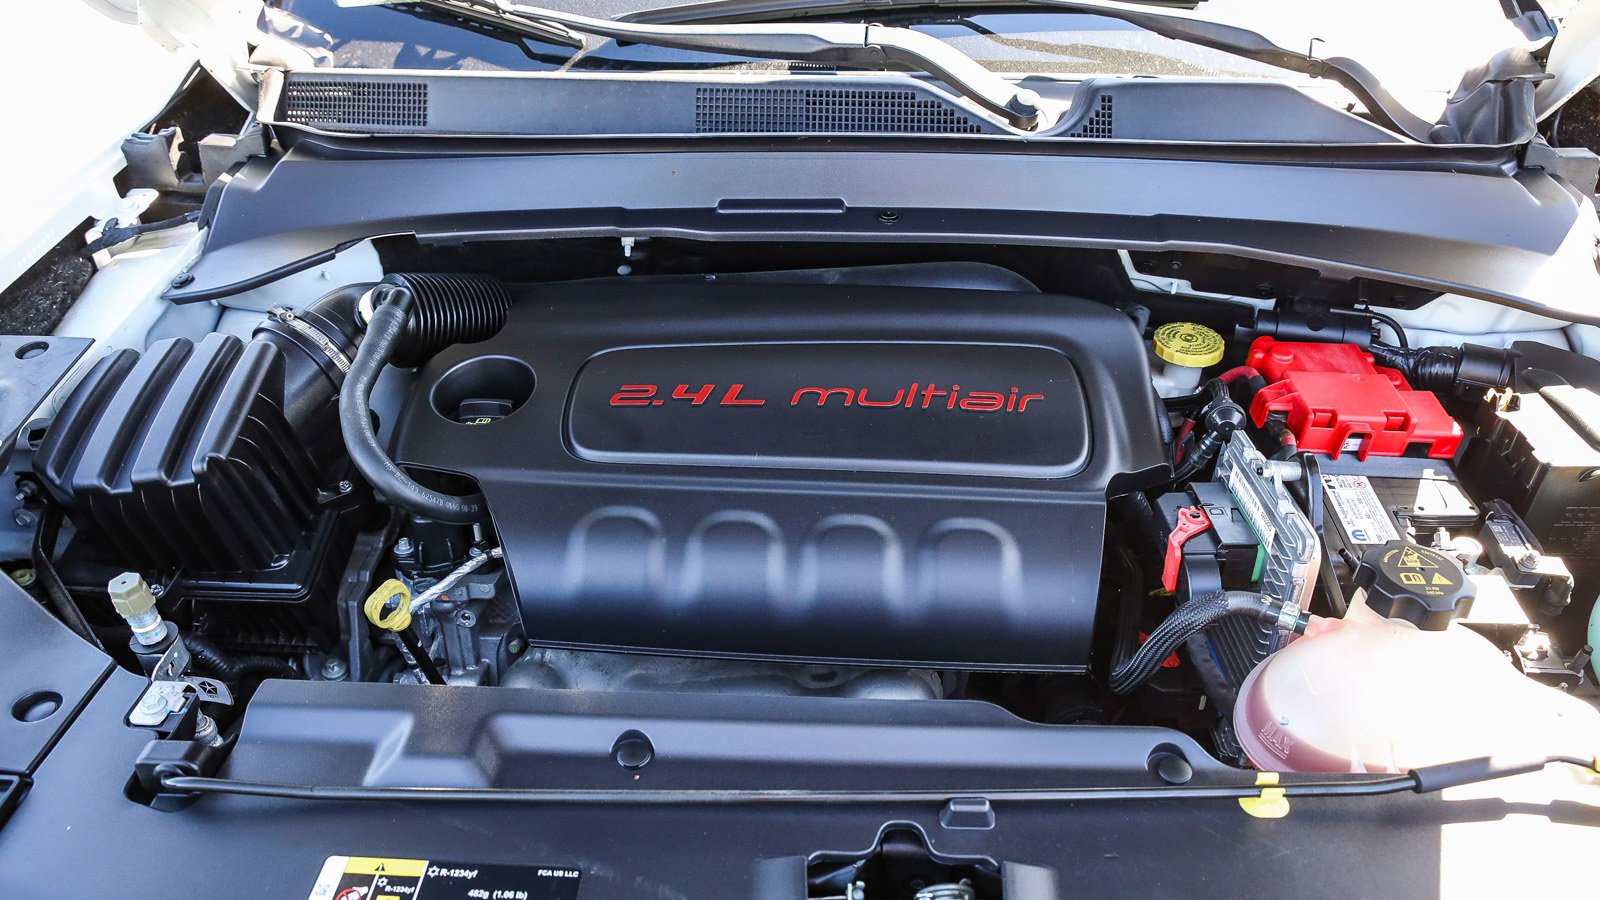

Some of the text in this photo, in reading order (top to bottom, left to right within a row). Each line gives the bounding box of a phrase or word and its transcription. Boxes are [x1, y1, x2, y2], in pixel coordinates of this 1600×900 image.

[790, 383, 1045, 412] multiair
[1261, 720, 1294, 754] MAX
[439, 869, 478, 880] R-1234yf
[537, 869, 579, 878] FCA US LLC
